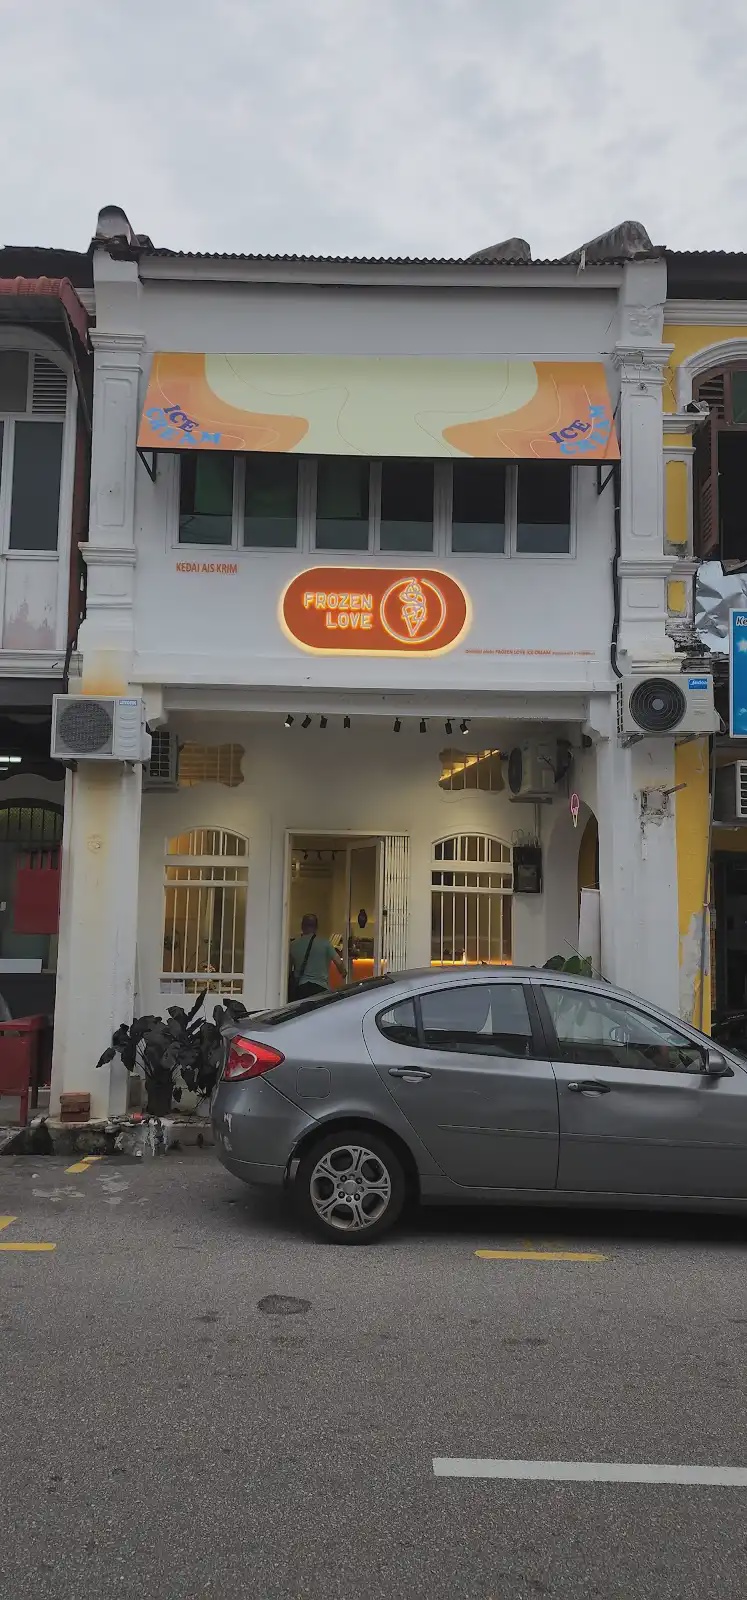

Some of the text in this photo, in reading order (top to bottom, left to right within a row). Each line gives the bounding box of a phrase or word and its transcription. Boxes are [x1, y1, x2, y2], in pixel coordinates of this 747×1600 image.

[145, 407, 222, 445] CREAM
[163, 405, 199, 432] ICE
[560, 405, 610, 455] CREAM
[549, 419, 592, 443] ICE
[176, 562, 238, 574] KEDAI AIS KRIM
[303, 591, 373, 610] FROZEN
[326, 611, 373, 629] LOVE
